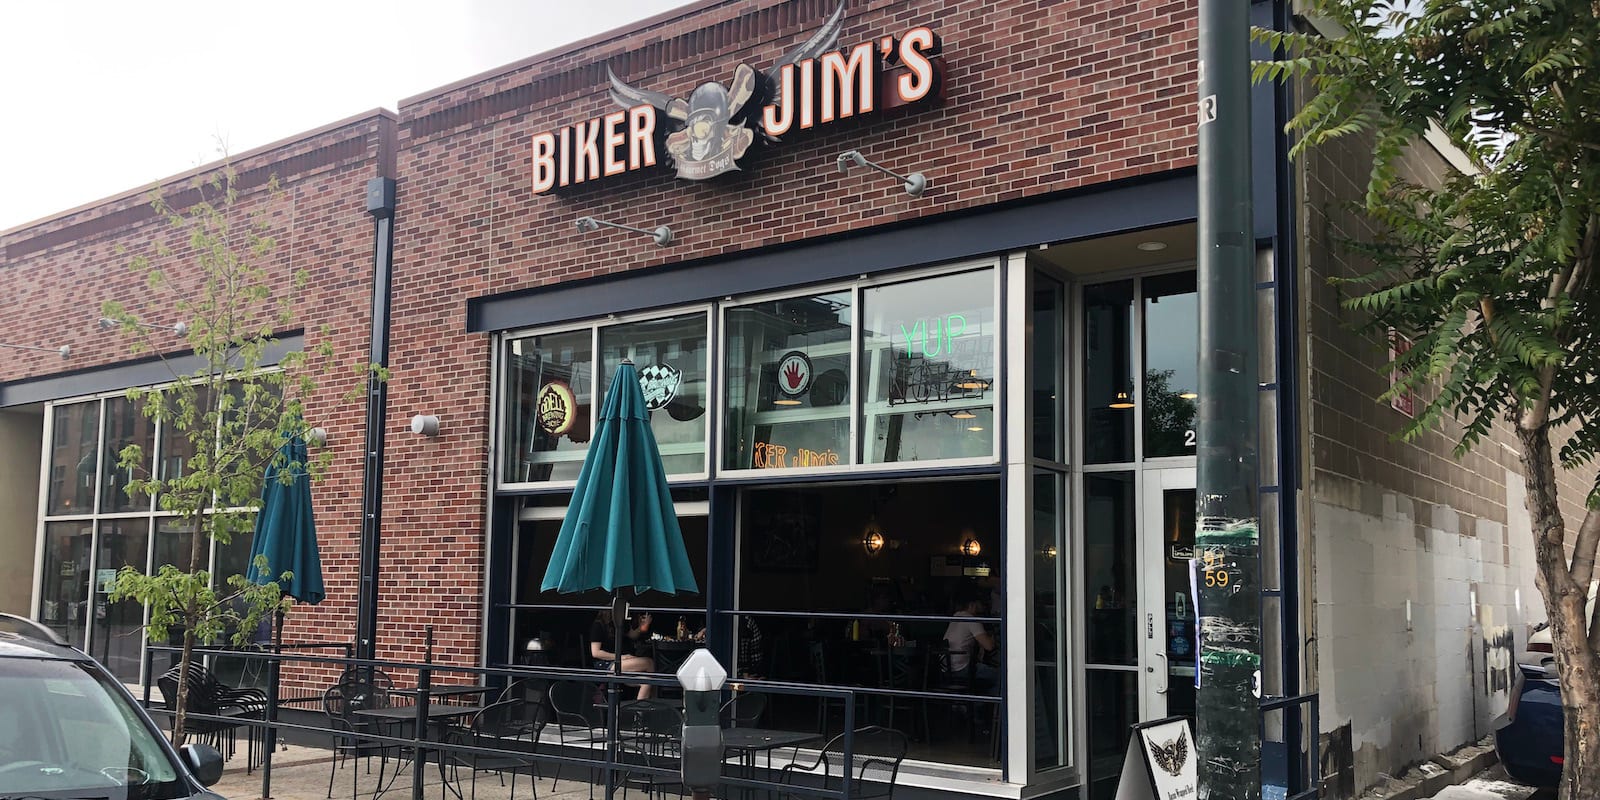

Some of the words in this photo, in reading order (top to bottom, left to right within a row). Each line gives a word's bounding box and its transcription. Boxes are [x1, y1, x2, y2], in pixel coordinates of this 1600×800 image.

[531, 104, 656, 194] BIKER
[763, 26, 934, 137] JIM'S
[900, 315, 966, 359] YUP
[541, 392, 565, 414] ODELL
[1184, 429, 1196, 446] 2
[1205, 570, 1229, 588] 59
